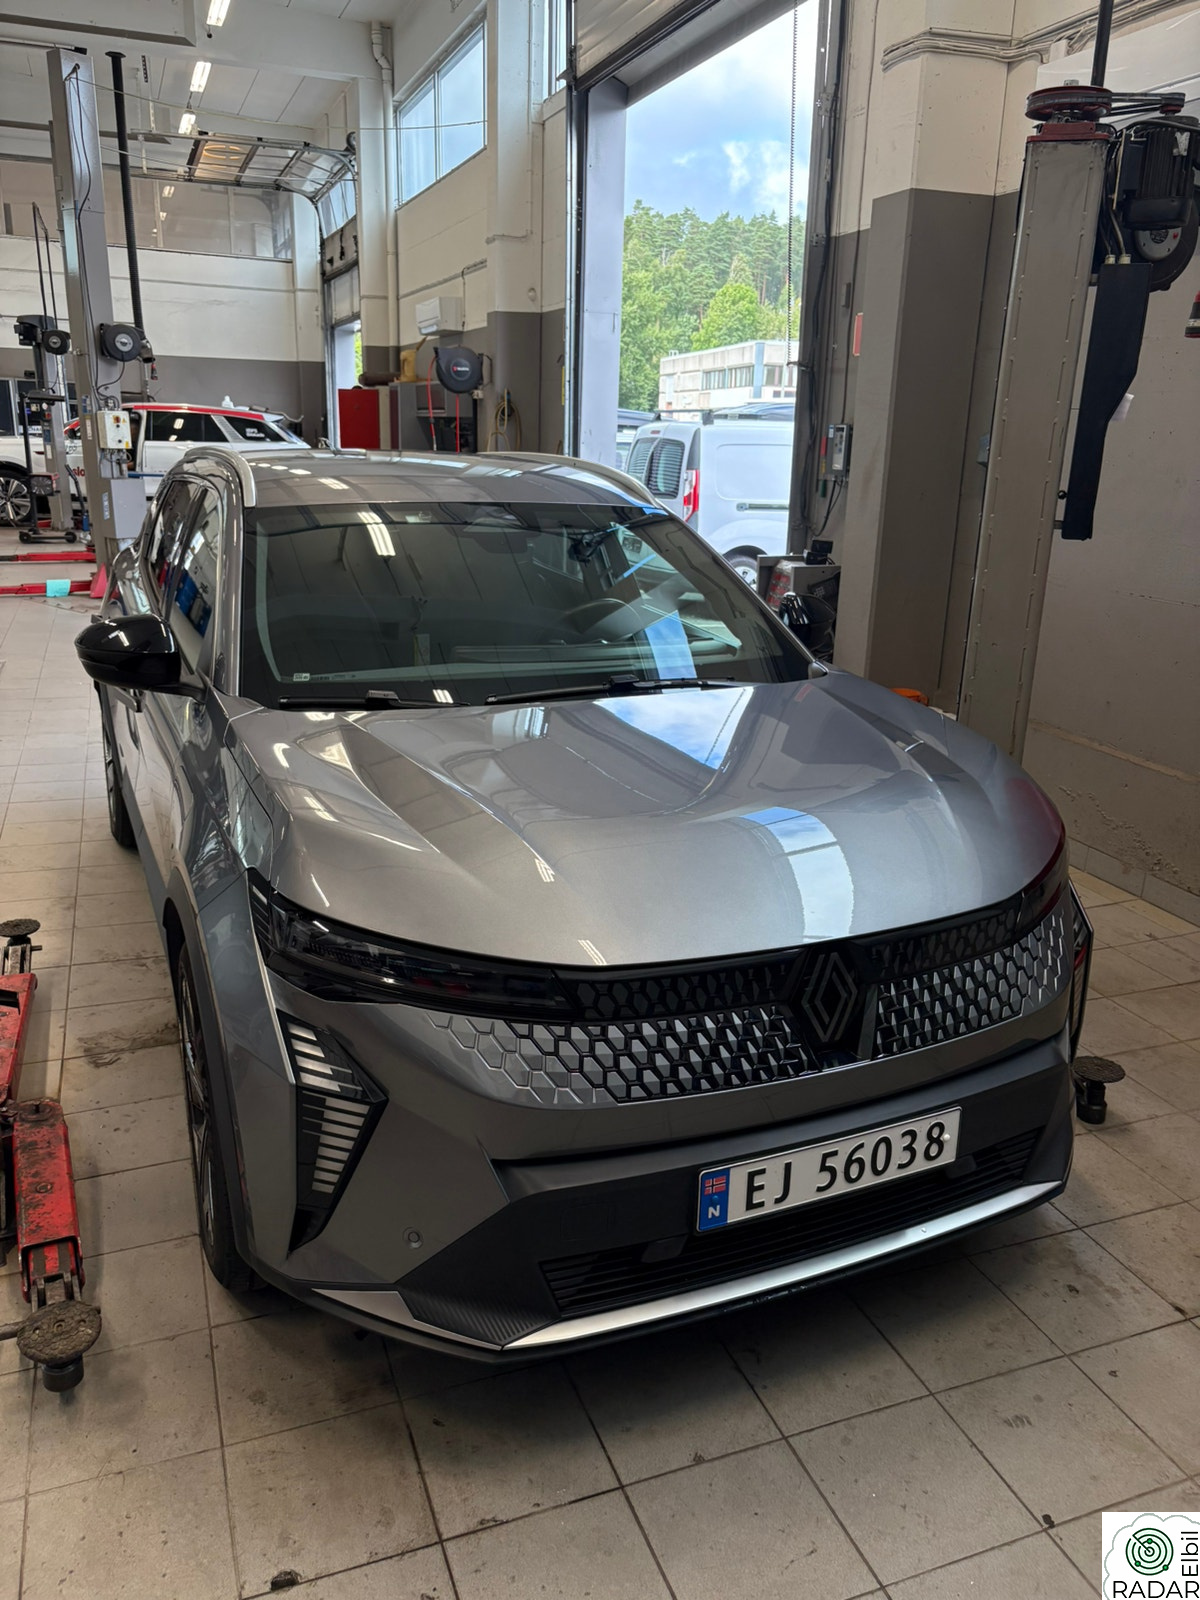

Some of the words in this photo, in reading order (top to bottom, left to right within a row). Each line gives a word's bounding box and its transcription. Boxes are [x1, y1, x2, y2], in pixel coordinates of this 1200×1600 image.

[745, 1161, 793, 1212] EJ
[816, 1121, 946, 1193] 56038
[707, 1204, 721, 1219] N
